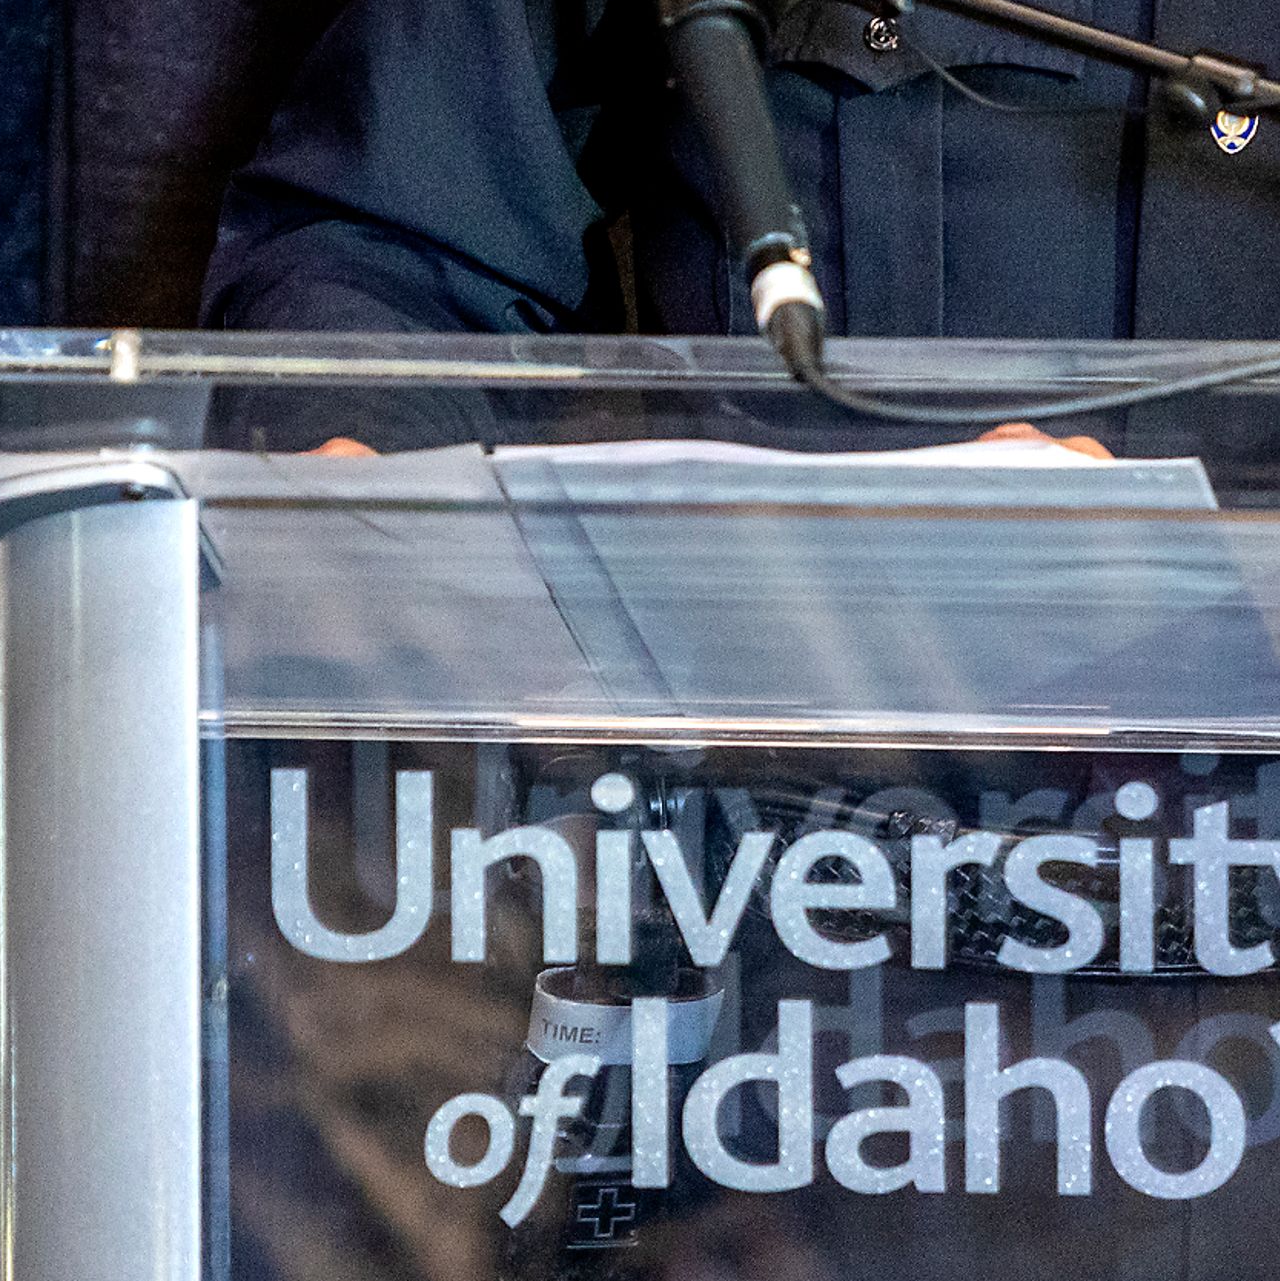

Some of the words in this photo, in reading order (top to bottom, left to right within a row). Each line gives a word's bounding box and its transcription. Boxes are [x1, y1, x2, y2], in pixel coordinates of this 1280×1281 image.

[540, 1018, 602, 1045] TIME:
[424, 1055, 603, 1228] of
[632, 997, 1248, 1200] Idaho
